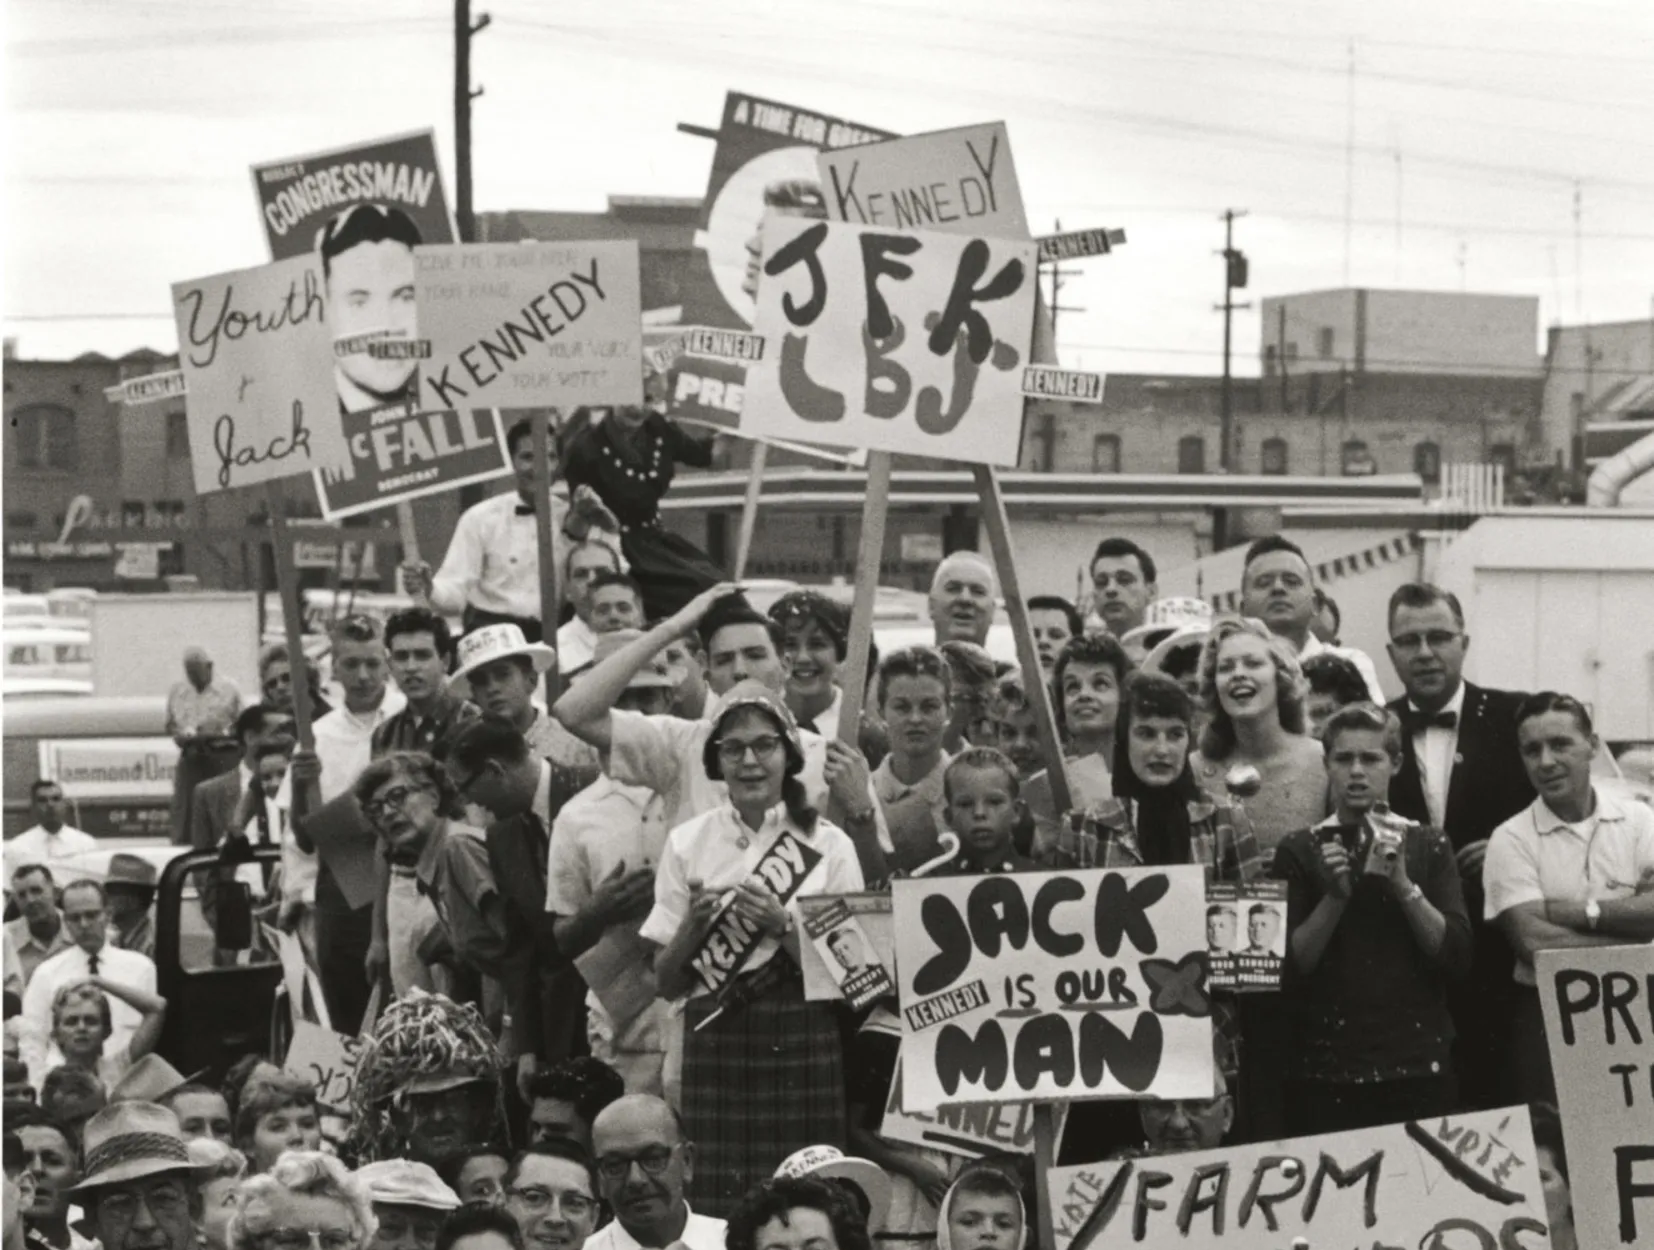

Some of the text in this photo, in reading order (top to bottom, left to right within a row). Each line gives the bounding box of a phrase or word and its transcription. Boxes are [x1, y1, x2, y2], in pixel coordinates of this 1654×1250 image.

[733, 100, 748, 124] A
[752, 102, 793, 136] TIME
[793, 113, 827, 144] FOR
[264, 160, 435, 236] CONGRESSMAN
[828, 135, 998, 228] KENNEDY
[1038, 230, 1107, 263] KENNEDY
[179, 269, 324, 368] Youth
[763, 221, 1024, 364] JFK
[426, 256, 606, 409] KENNEDY
[692, 329, 764, 360] KENNEDY
[674, 372, 746, 413] PRE
[779, 312, 1020, 436] LBJ
[1023, 367, 1099, 398] KENNEDY
[213, 398, 311, 488] Jack
[691, 835, 806, 991] KENDY
[912, 871, 1170, 996] JACK
[1004, 966, 1138, 1009] IS OUR
[1239, 958, 1281, 969] KENNEDY
[905, 981, 989, 1031] KENNEDY
[935, 1010, 1163, 1096] MAN
[1609, 1063, 1654, 1107] T
[1437, 1115, 1526, 1186] VOTE
[1053, 1170, 1105, 1241] VOTE
[1131, 1149, 1385, 1242] FARM
